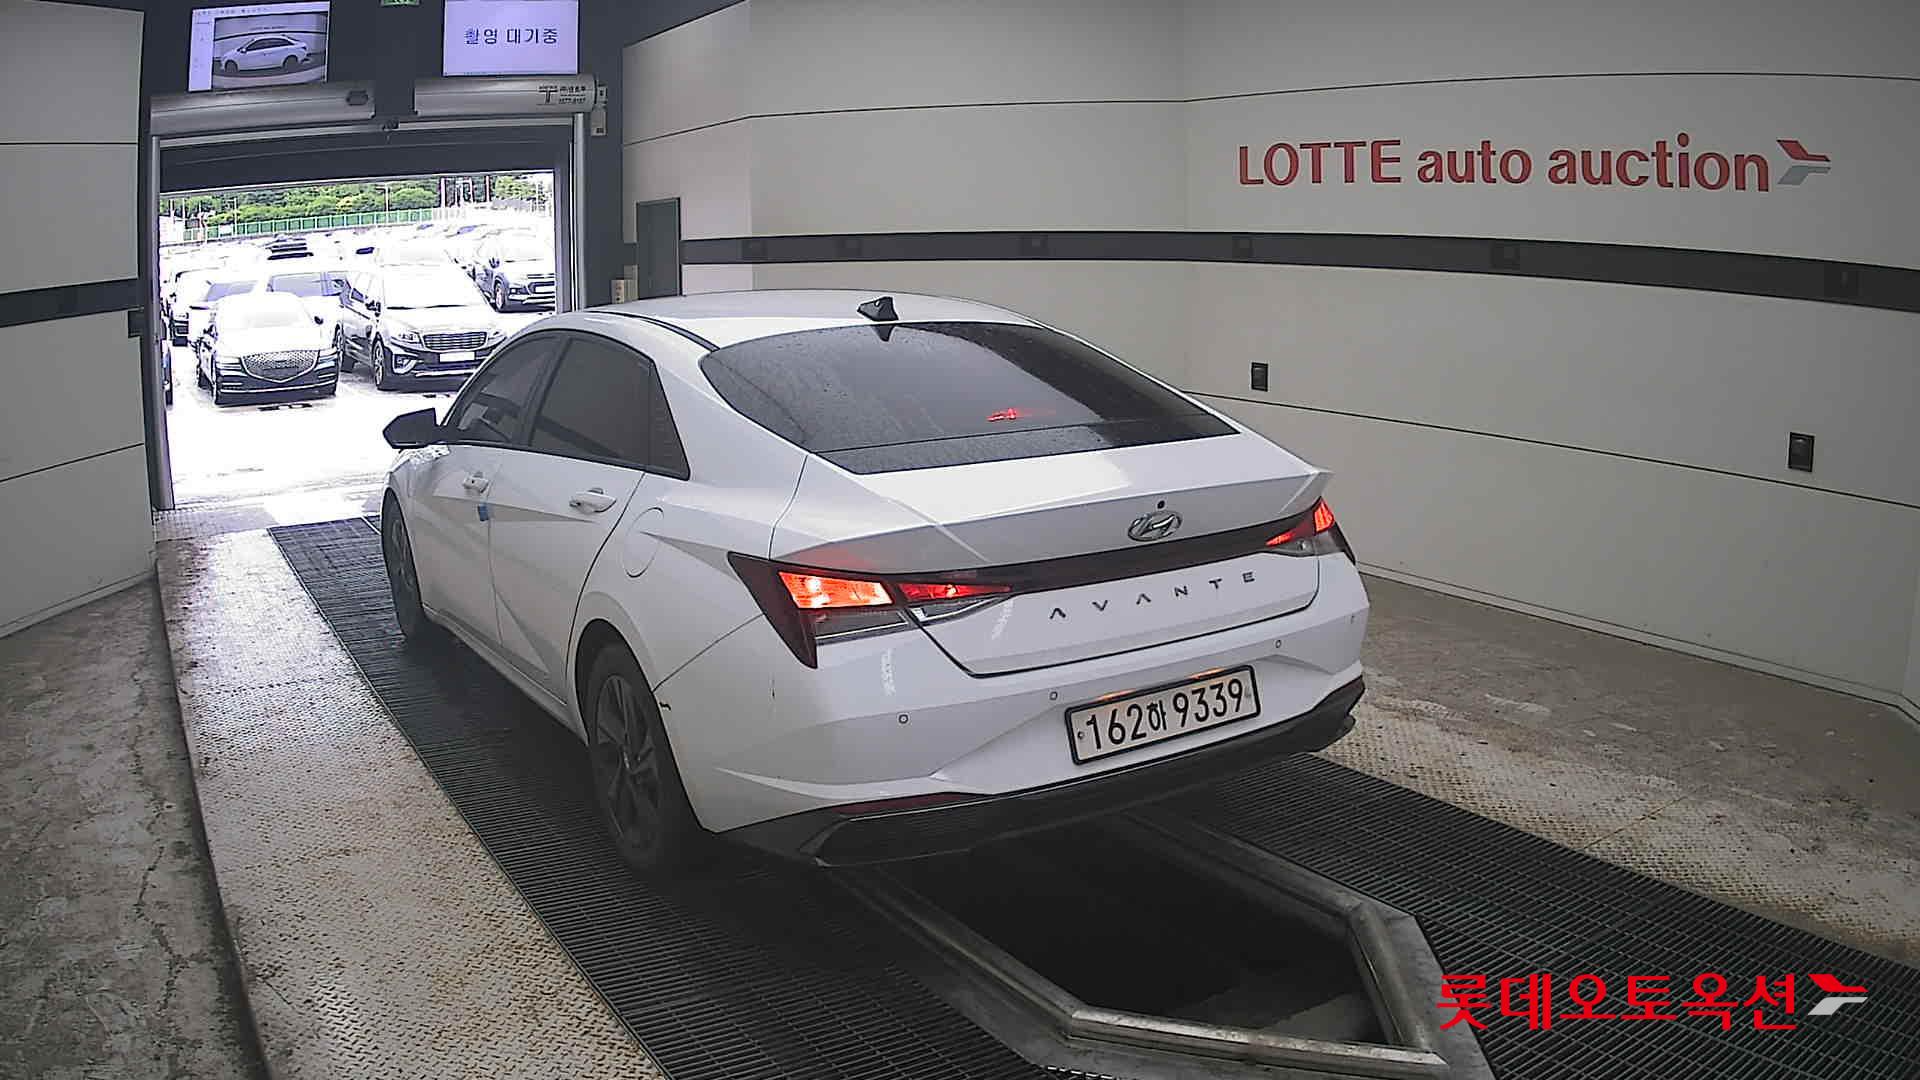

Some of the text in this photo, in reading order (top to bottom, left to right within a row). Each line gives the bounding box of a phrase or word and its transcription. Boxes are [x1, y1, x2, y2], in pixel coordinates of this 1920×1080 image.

[506, 27, 558, 45] 대기중
[1239, 132, 1770, 193] LOTTE auto auction
[1049, 570, 1256, 620] AVANTE
